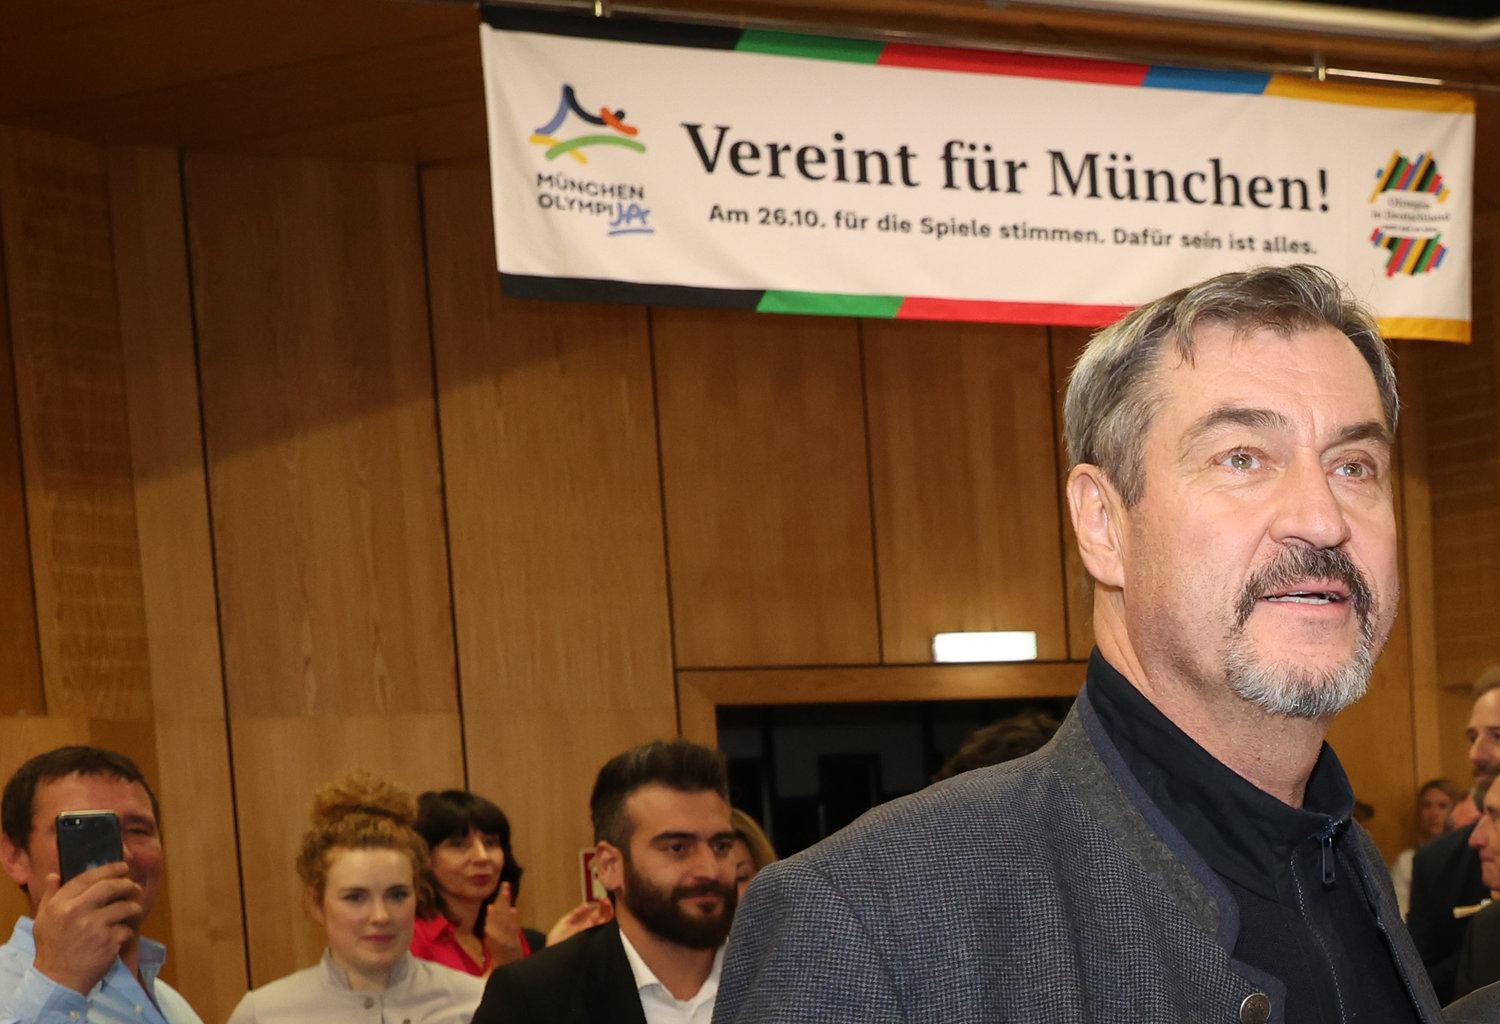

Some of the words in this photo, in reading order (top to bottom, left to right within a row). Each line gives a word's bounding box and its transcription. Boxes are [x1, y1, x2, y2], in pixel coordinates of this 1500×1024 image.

[537, 171, 645, 200] MÜNCHEN
[680, 122, 920, 187] Vereint
[939, 139, 1028, 194] für
[1047, 150, 1329, 213] München!
[709, 205, 749, 224] Am
[757, 208, 825, 228] 26.10.
[834, 211, 868, 230] für
[877, 214, 912, 233] die
[920, 217, 991, 240] Spiele
[1000, 222, 1106, 243] stimmen.
[1113, 227, 1174, 246] Dafür
[1181, 231, 1222, 249] sein
[1229, 233, 1256, 250] ist
[1262, 236, 1318, 255] alles.
